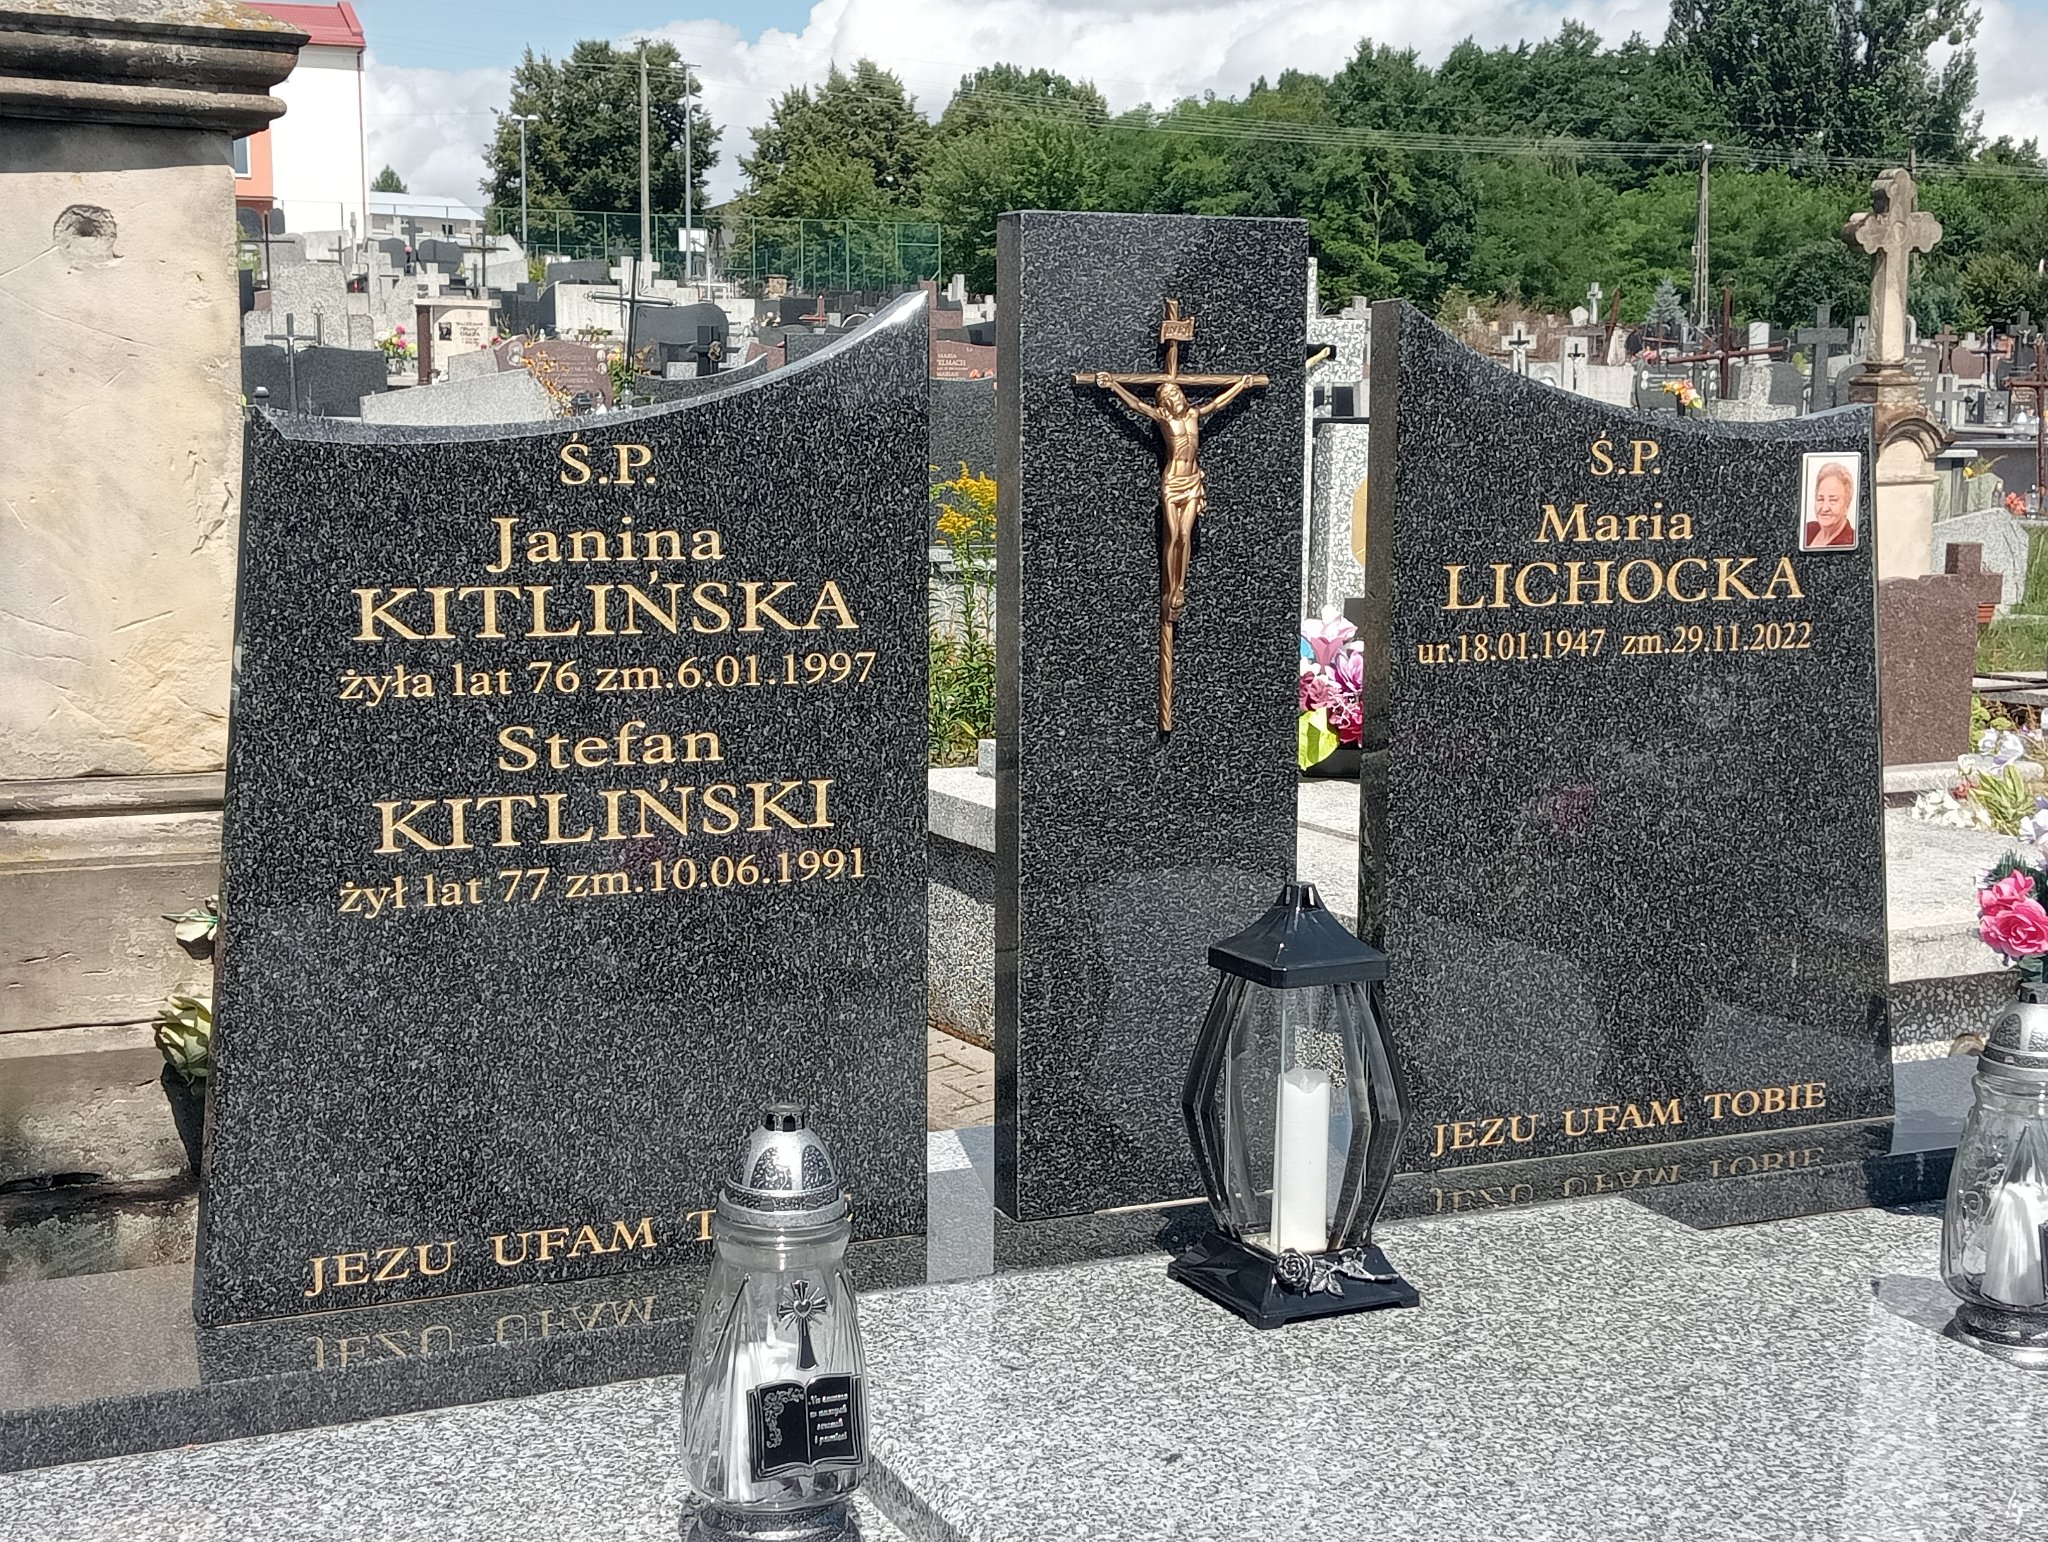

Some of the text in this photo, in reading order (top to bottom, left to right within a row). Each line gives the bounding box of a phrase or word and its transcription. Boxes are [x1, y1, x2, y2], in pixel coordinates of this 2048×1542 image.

[559, 433, 656, 485] Ś.P.
[1589, 430, 1661, 476] Ś.P.
[486, 515, 725, 573] Janina
[1534, 501, 1694, 544] Maria
[351, 571, 859, 642] KITLIŃSKA
[1442, 556, 1806, 611] LICHOCKA
[1417, 621, 1812, 665] ur.18.01.1947 zm.29.11.2022
[339, 651, 877, 707] żyła lat 76 zm.6.01.1997
[497, 720, 724, 772] Stefan
[373, 778, 835, 854] KITLIŃSKI
[339, 847, 866, 919] żył lat 77 zm.10.06.1991
[1430, 1081, 1827, 1158] JEZU UFAM TOBIE
[303, 1241, 456, 1298] JEZU
[492, 1216, 659, 1267] UFAM
